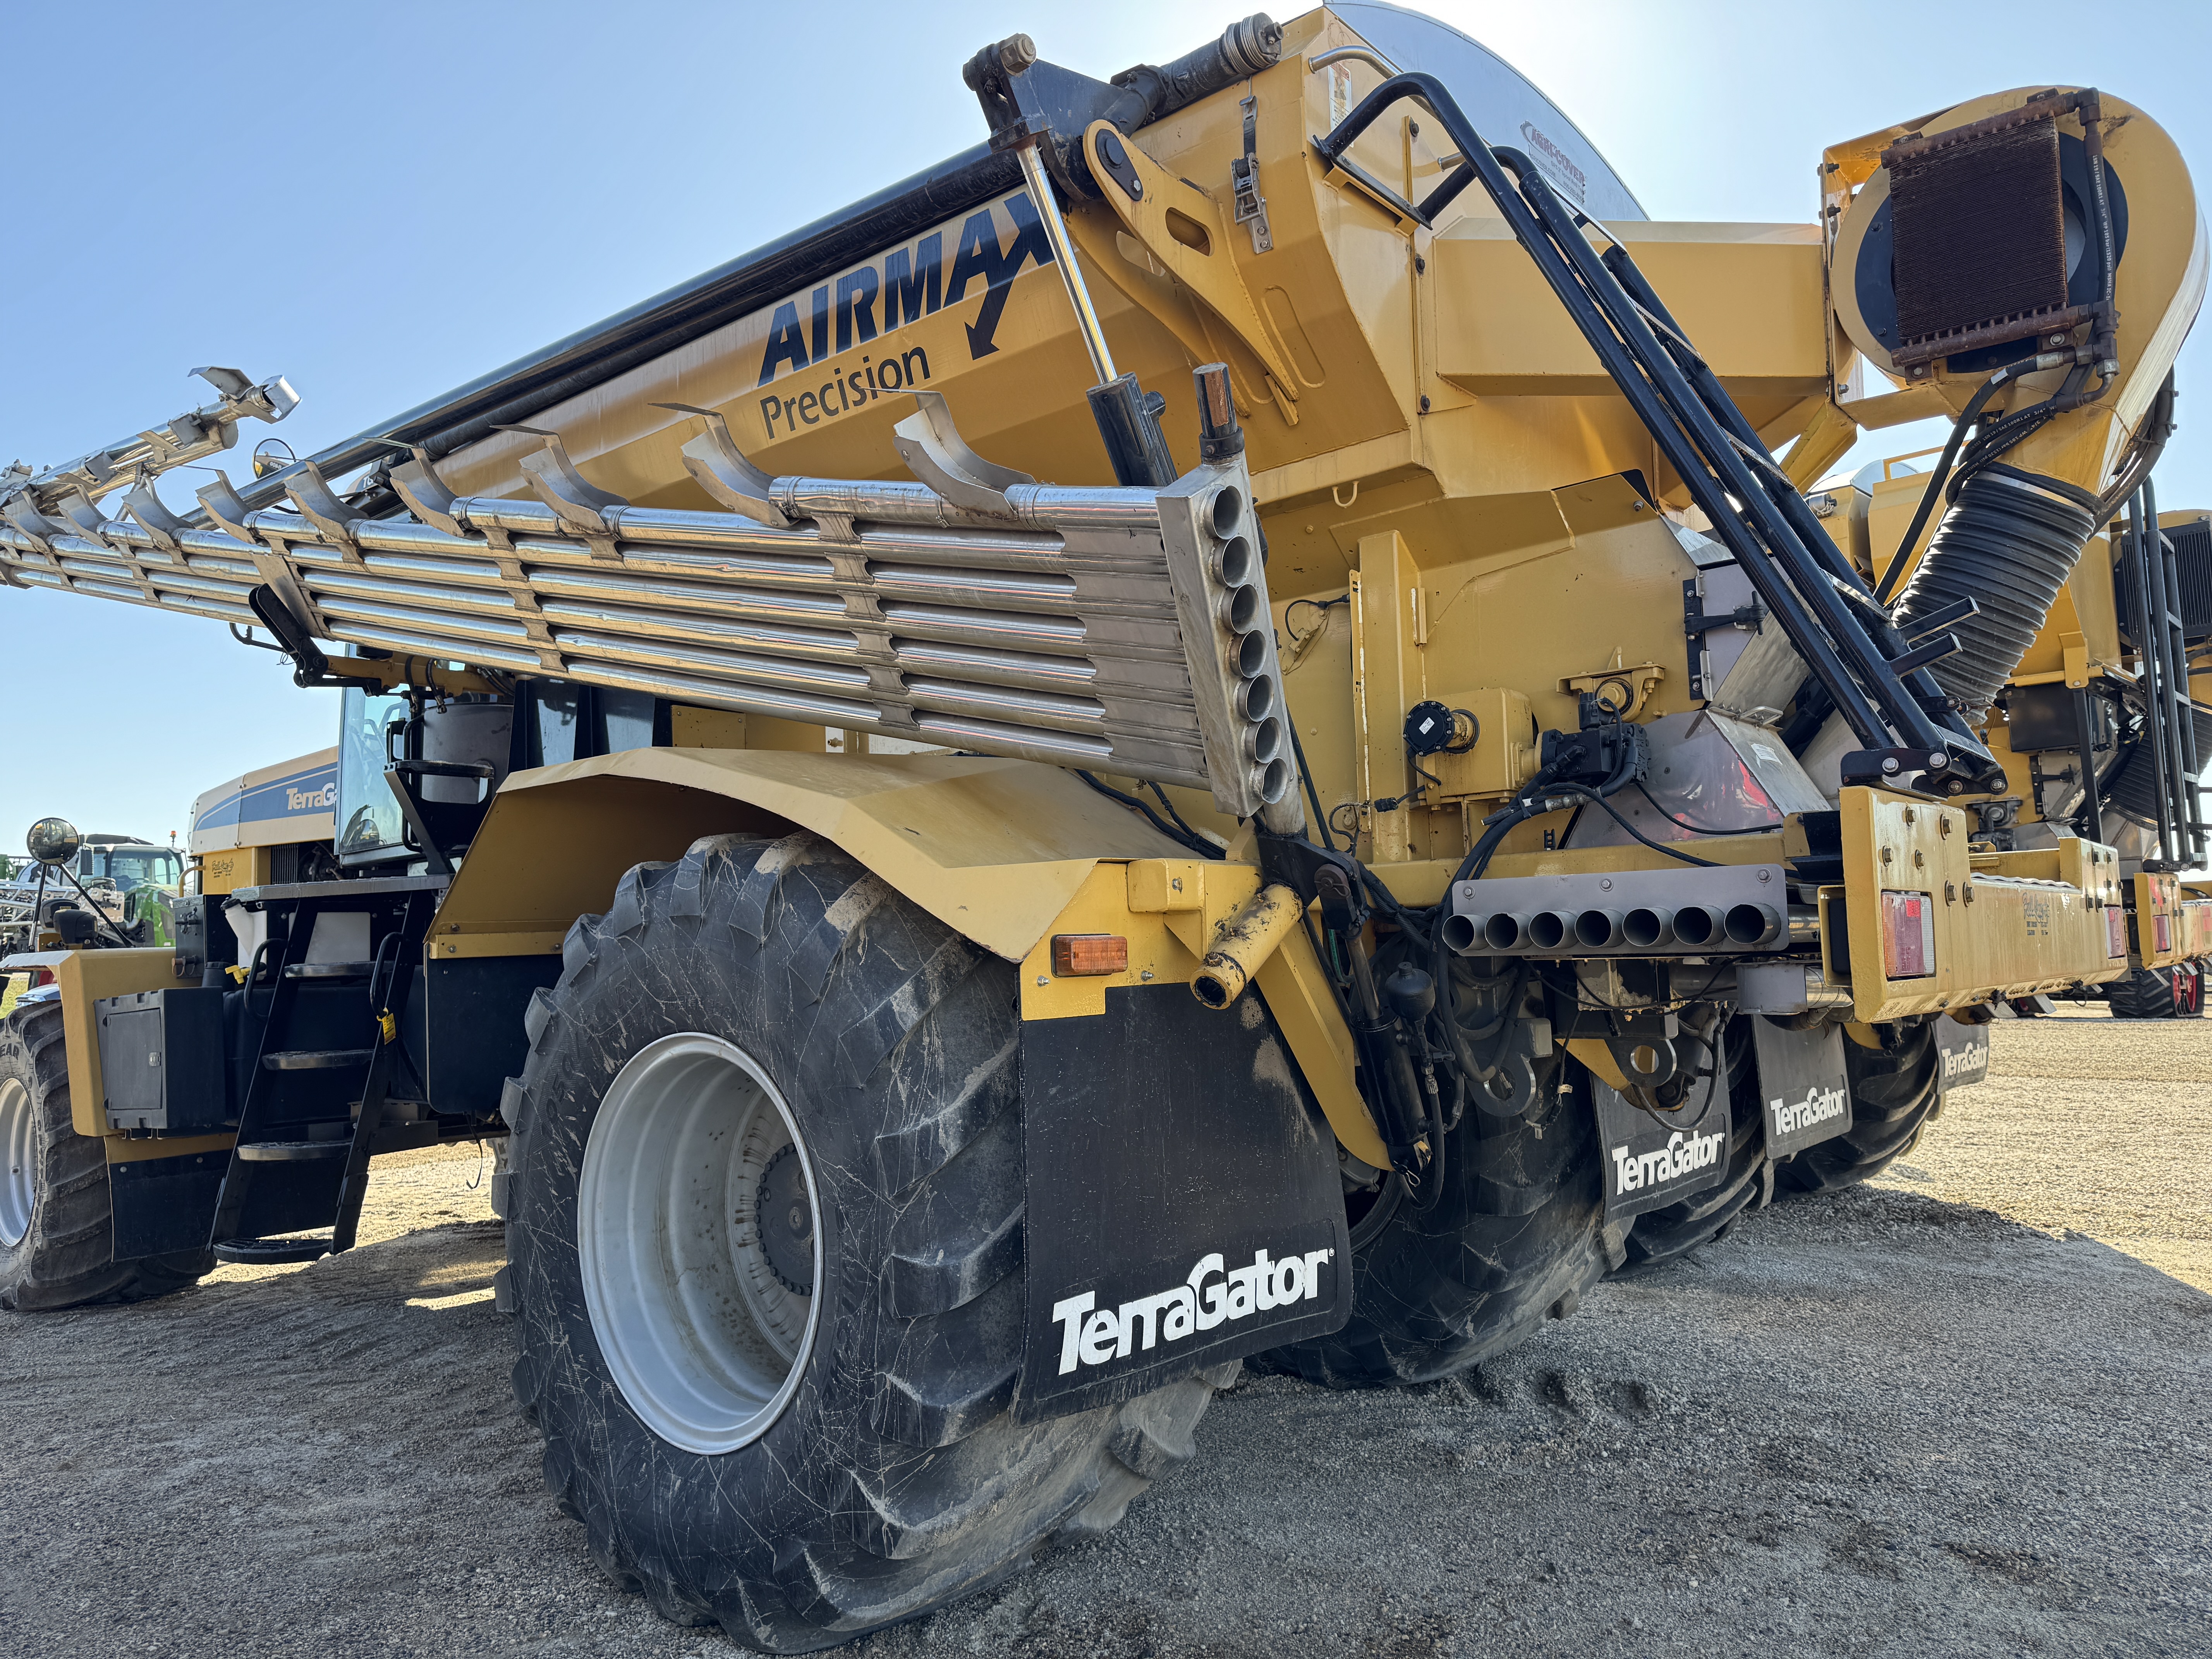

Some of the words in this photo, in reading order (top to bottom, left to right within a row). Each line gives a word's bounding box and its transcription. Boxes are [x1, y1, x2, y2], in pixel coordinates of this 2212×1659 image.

[1532, 128, 1585, 184] AGRI-COVER
[2103, 221, 2108, 229] WP
[757, 191, 1055, 387] AIRMAX
[760, 346, 931, 440] Precision
[2008, 417, 2023, 426] 100R1
[2009, 436, 2019, 444] 105
[1941, 1042, 1989, 1077] TerraGator
[1769, 1087, 1845, 1135] TerraGator
[1611, 1131, 1724, 1195] TerraGator
[1052, 1248, 1331, 1376] TerraGator
